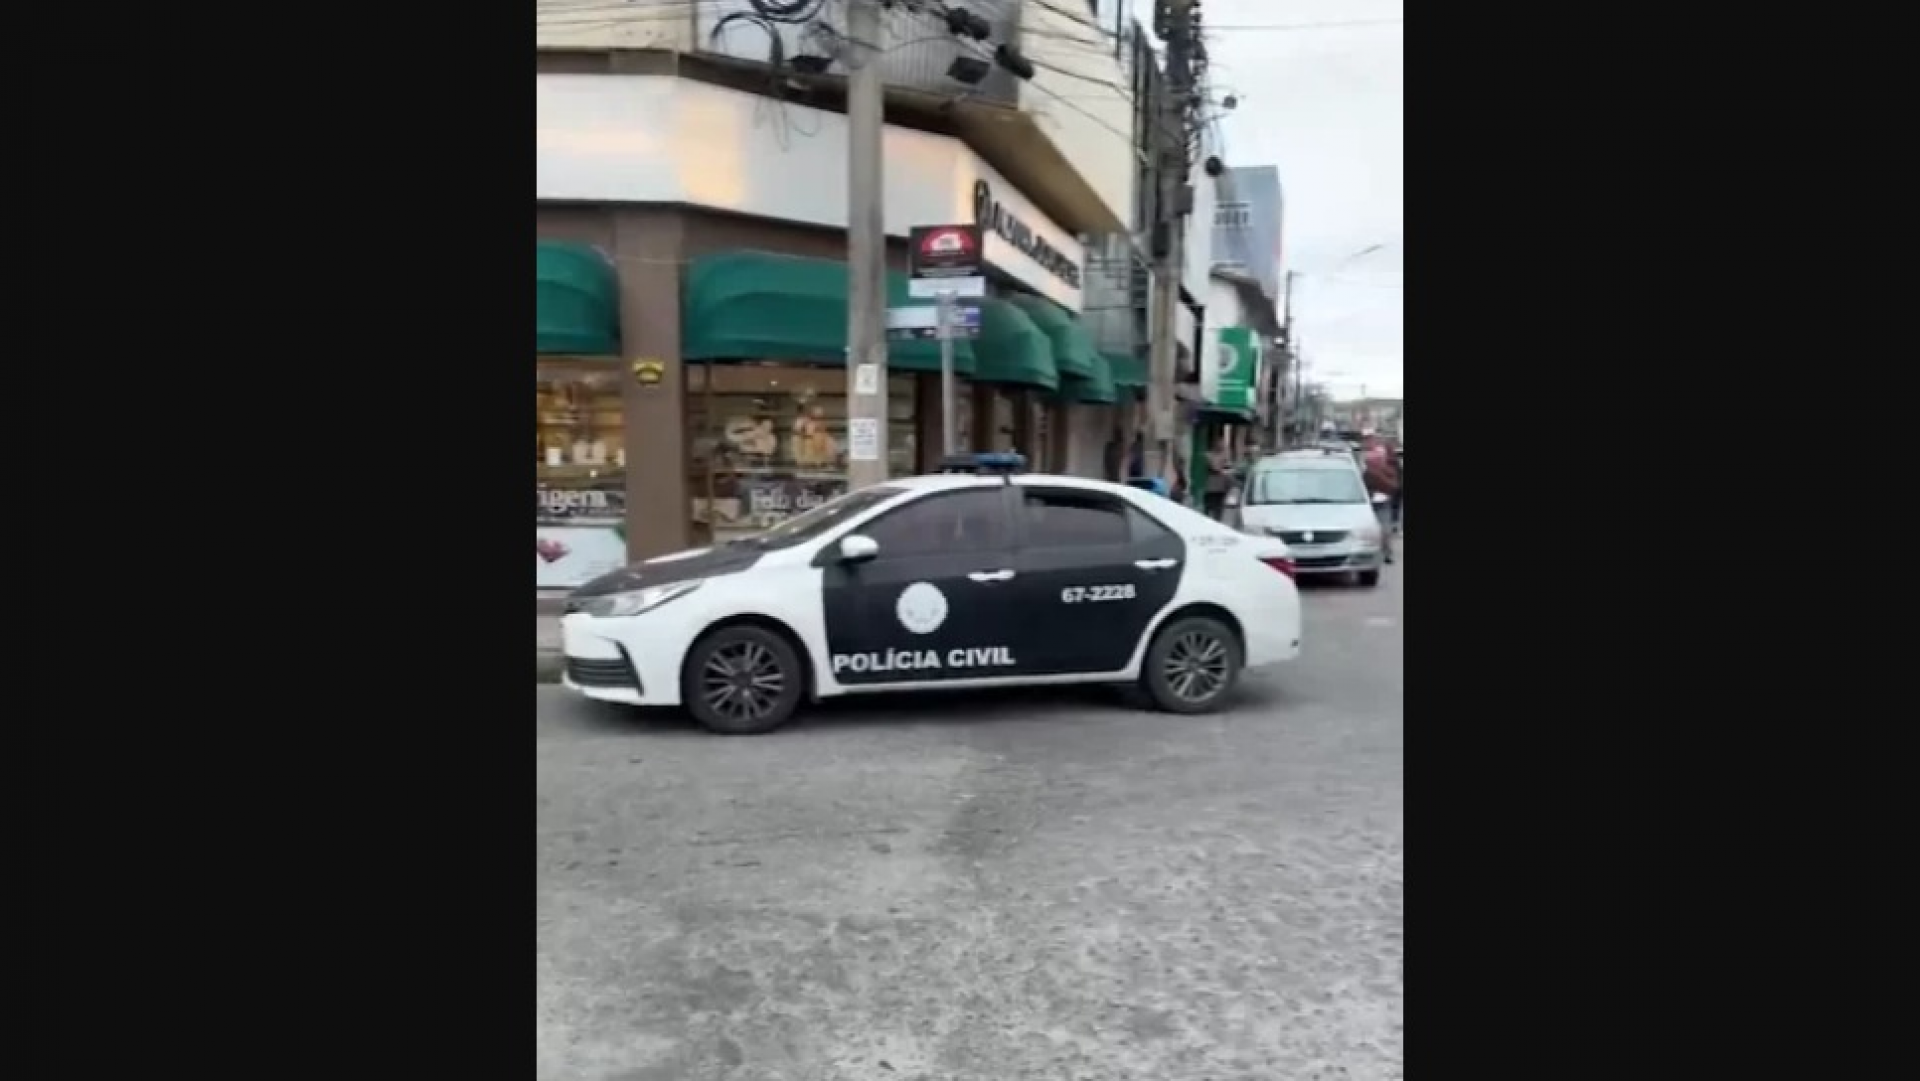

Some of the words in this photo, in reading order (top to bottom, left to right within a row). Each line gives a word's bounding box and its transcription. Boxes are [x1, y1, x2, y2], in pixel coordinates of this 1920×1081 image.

[1061, 584, 1136, 602] 67-2228
[833, 648, 942, 673] POLÍCIA
[948, 646, 1016, 667] CIVIL
